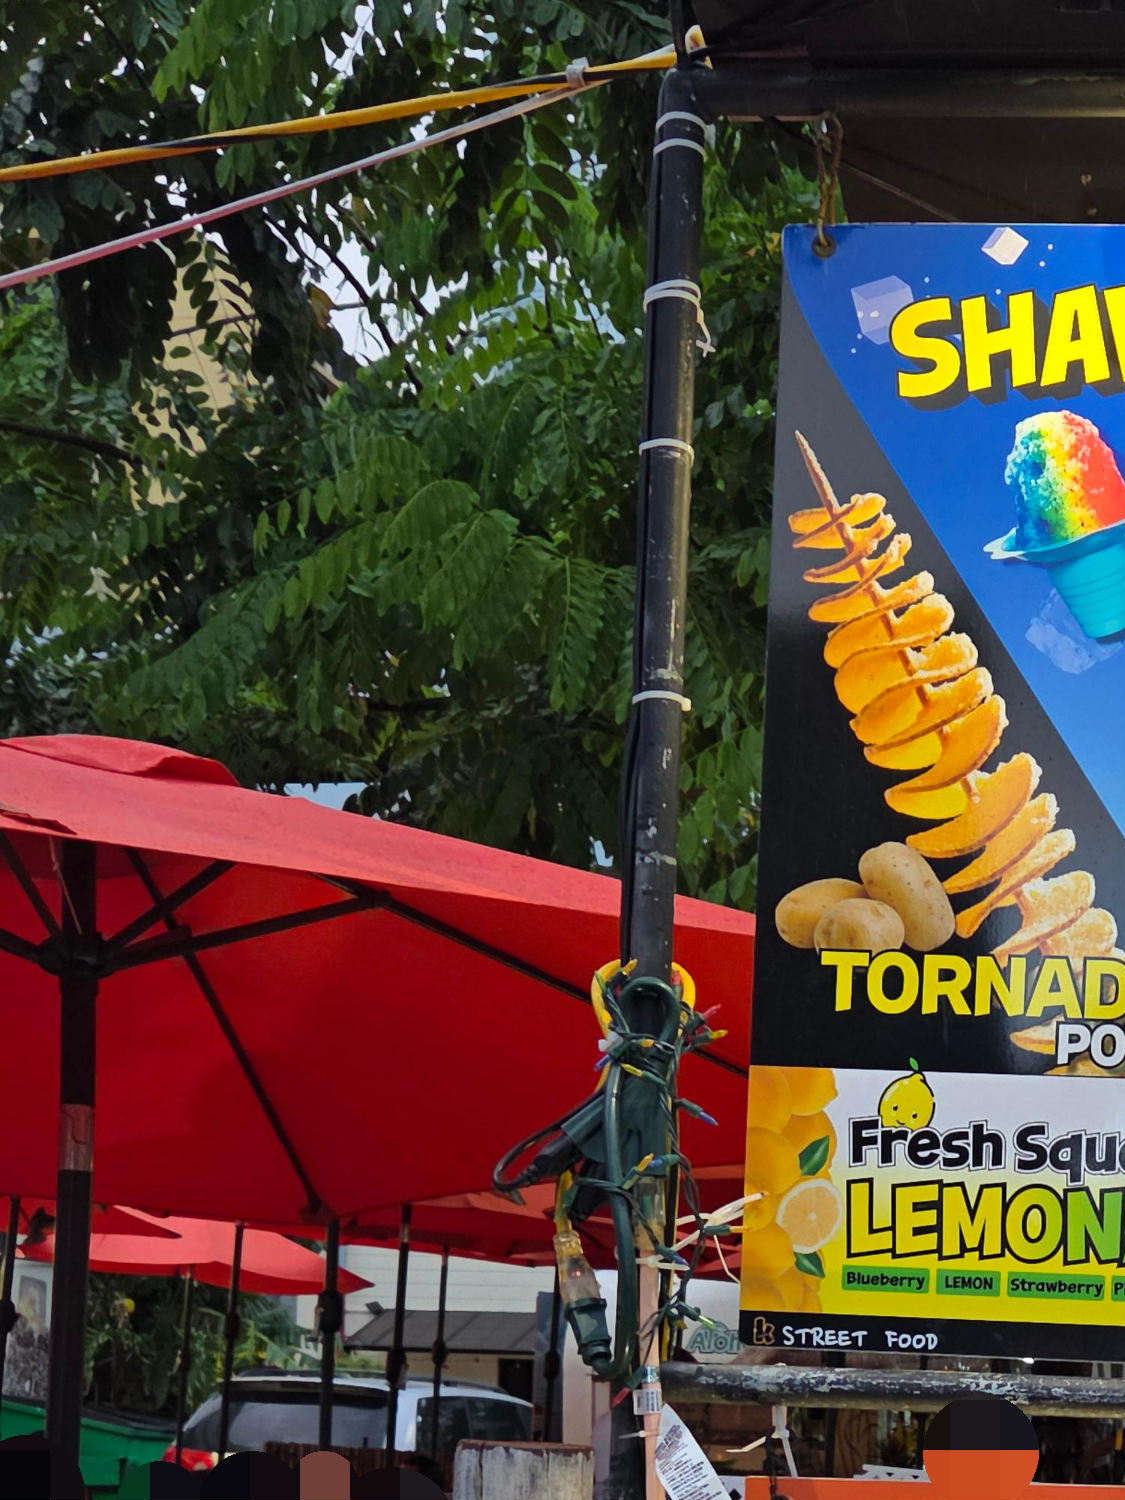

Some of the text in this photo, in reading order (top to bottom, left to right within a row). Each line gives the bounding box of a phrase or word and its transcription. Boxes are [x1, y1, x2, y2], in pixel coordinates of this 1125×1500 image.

[848, 1118, 1004, 1172] Fresh
[846, 1270, 926, 1291] Blueberry
[944, 1274, 994, 1290] LEMON
[1010, 1277, 1103, 1297] Strawberry
[782, 1324, 868, 1347] STREET
[884, 1330, 939, 1351] FOOD
